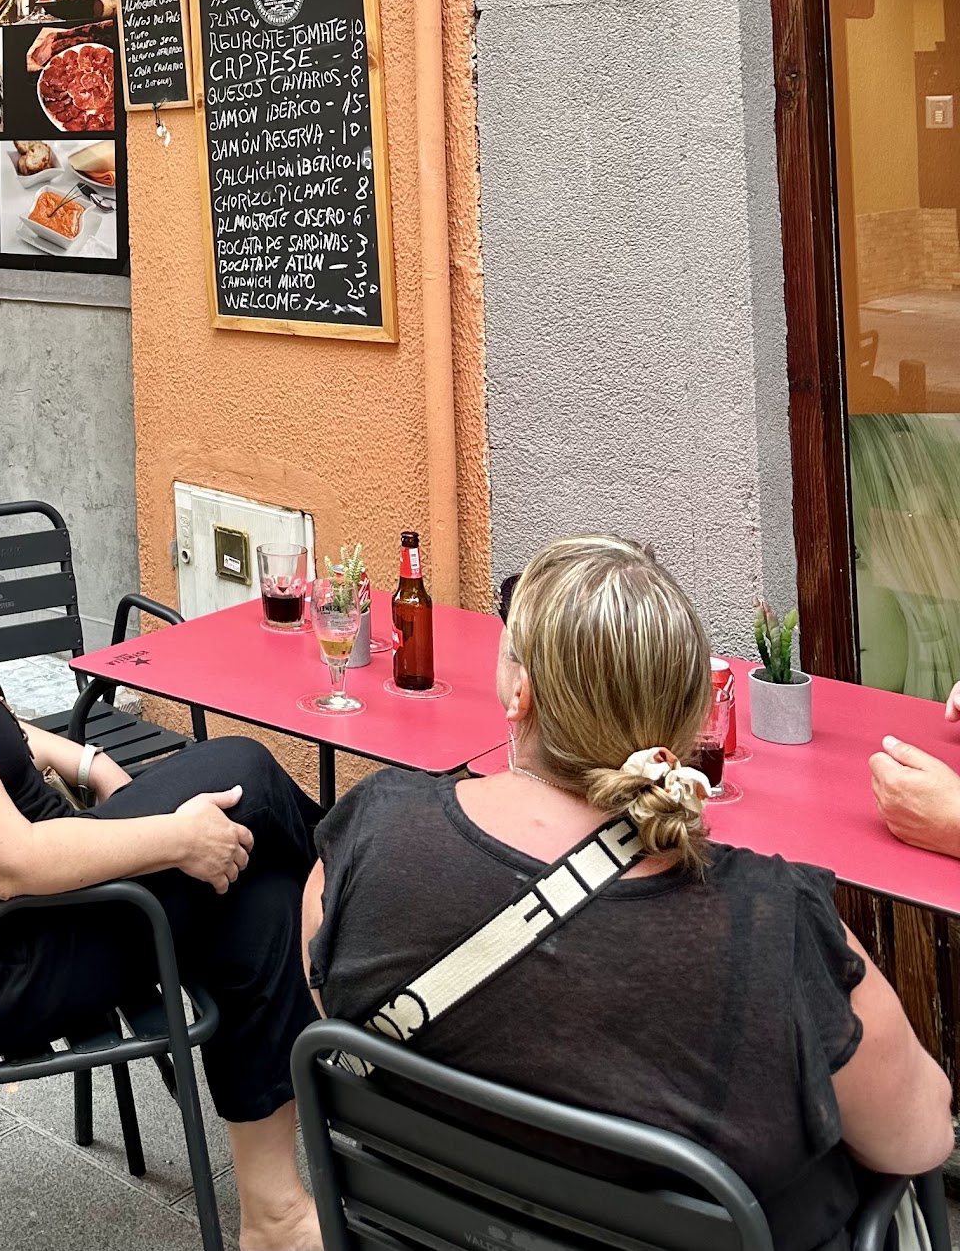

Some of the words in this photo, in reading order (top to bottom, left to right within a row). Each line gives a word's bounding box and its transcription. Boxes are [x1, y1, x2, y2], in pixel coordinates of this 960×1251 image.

[207, 78, 267, 106] QUESOS
[261, 123, 324, 152] RESERVA
[217, 236, 264, 257] BOCATA
[266, 236, 284, 253] DE
[219, 257, 263, 274] BOCATA
[355, 261, 368, 278] 3
[278, 274, 315, 290] MIXTO
[224, 291, 301, 311] WELCOME
